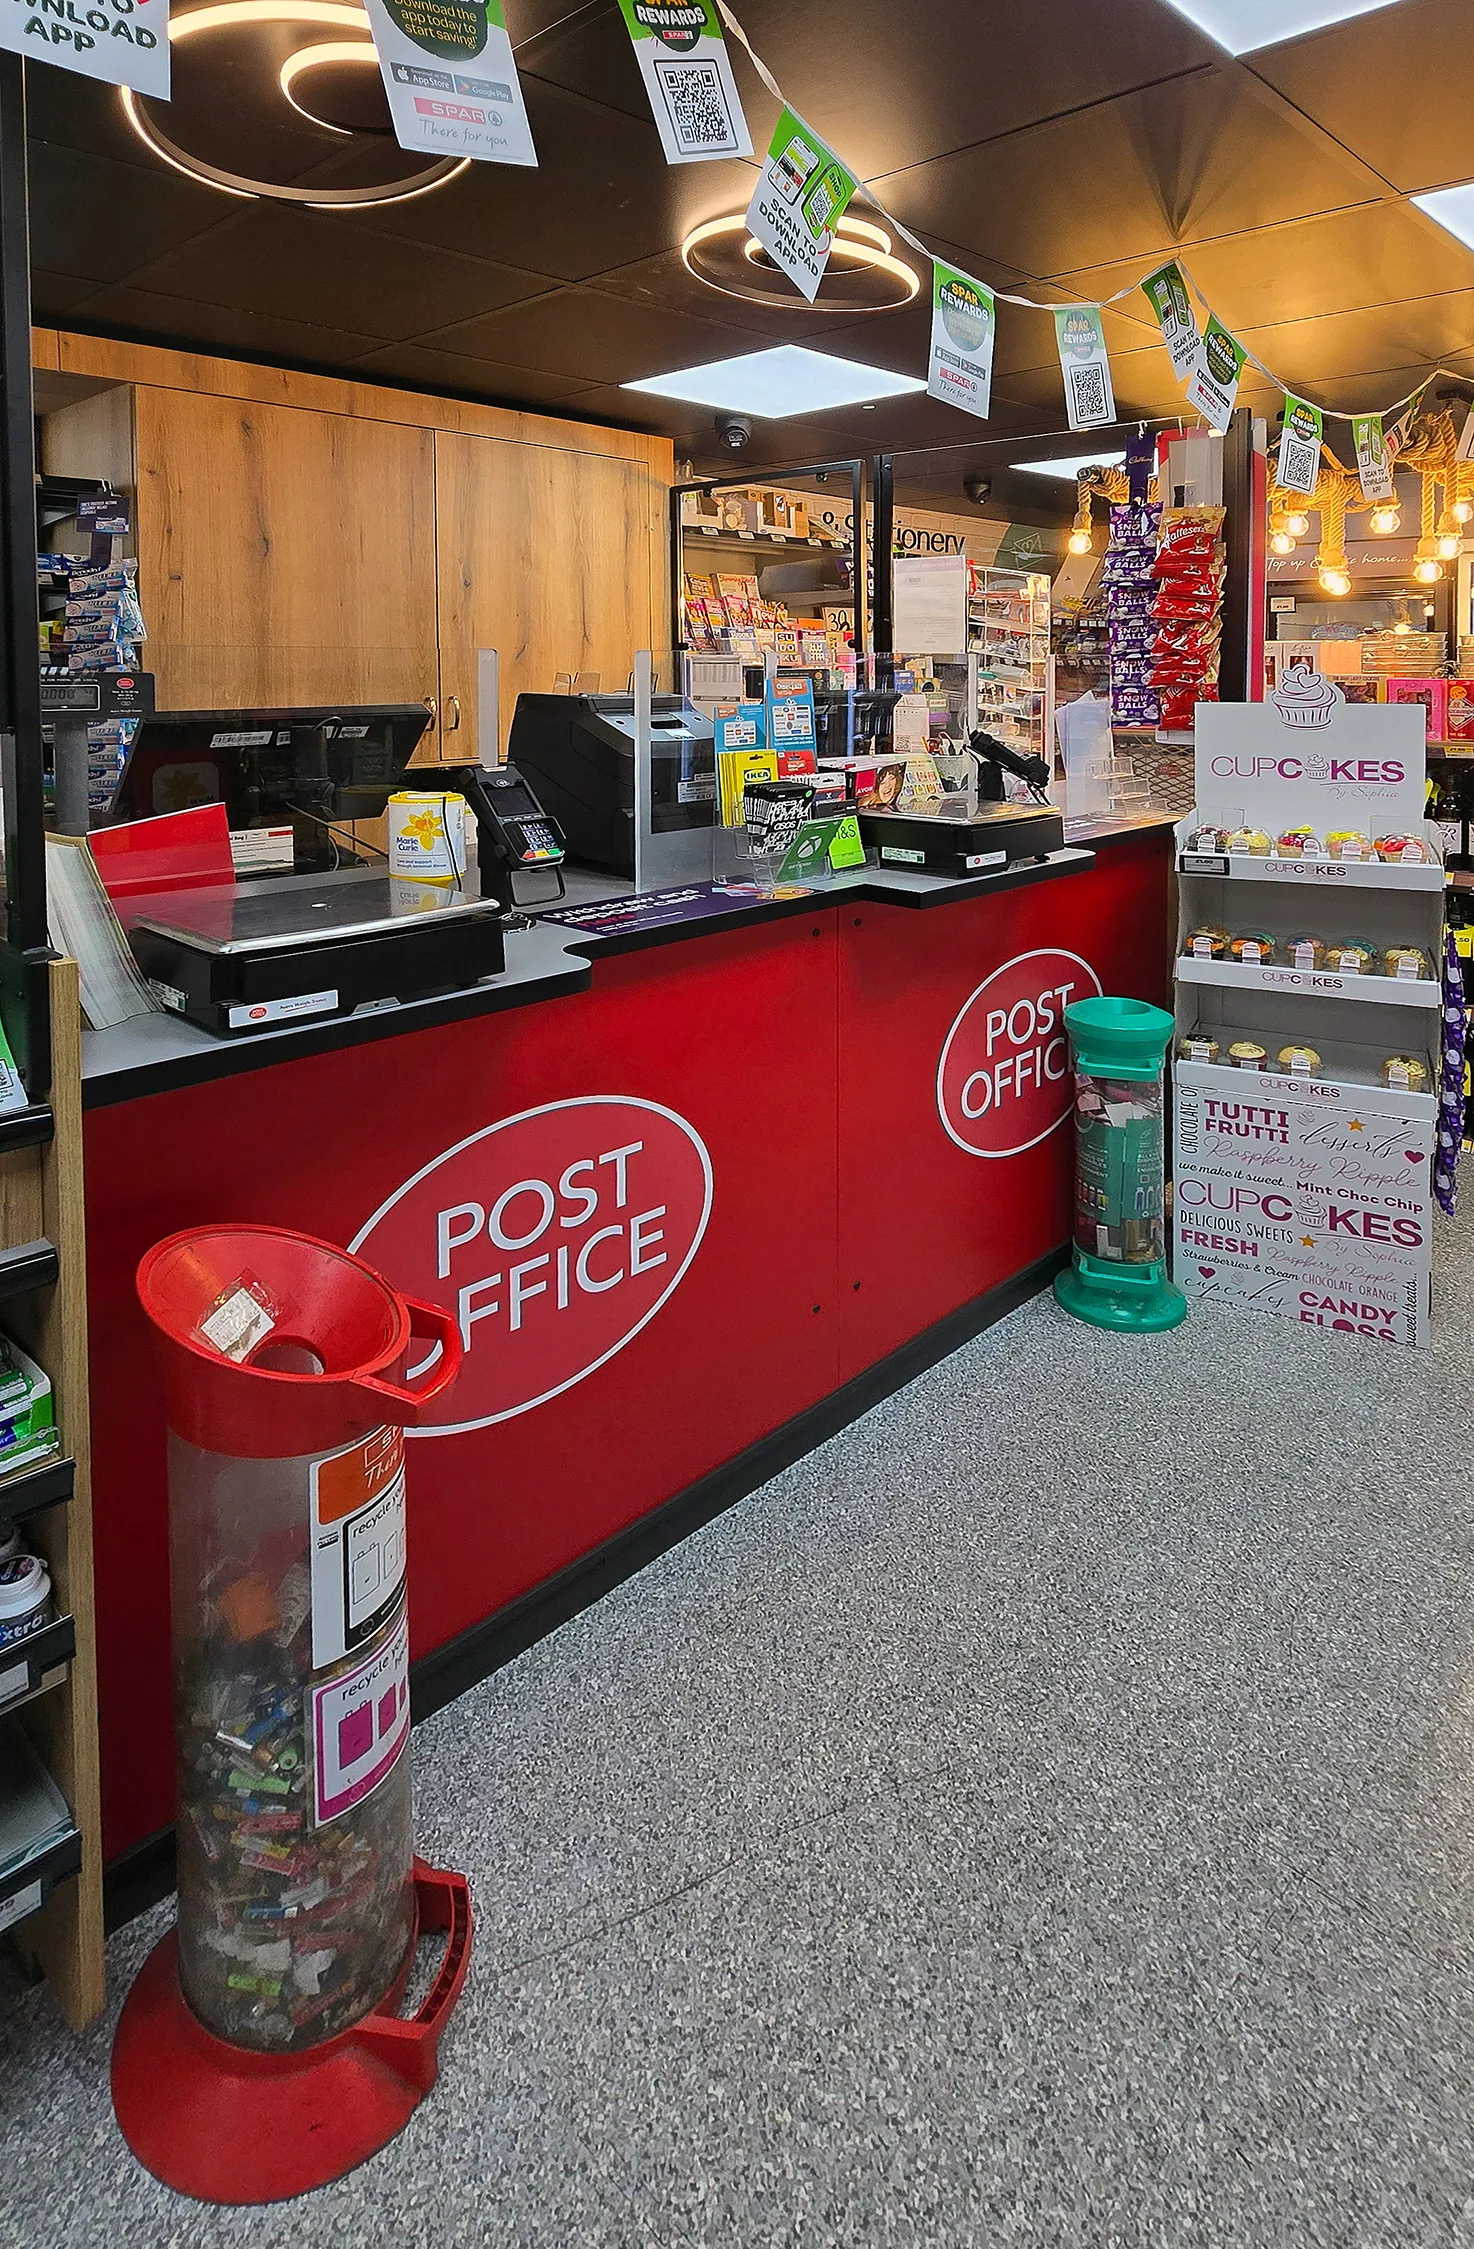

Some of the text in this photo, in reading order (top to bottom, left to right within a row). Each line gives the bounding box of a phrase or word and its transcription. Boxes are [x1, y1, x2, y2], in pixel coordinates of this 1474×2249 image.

[13, 0, 157, 49] NLOAD
[401, 10, 476, 34] app today to
[457, 8, 477, 22] the
[636, 4, 705, 25] REWARDS
[24, 16, 96, 52] APP
[405, 23, 435, 38] start
[413, 75, 450, 89] App Store
[472, 86, 496, 98] Google
[431, 102, 485, 122] SPAR
[419, 119, 458, 138] There
[462, 127, 482, 144] for
[486, 136, 508, 151] you
[829, 172, 841, 197] SHOP
[771, 198, 817, 256] SCAN TO
[759, 201, 819, 277] DOWNLOAD
[774, 240, 798, 265] APP
[940, 287, 989, 322] REWARDS
[951, 282, 978, 306] SPAR
[1068, 320, 1089, 332] SPAR
[1063, 331, 1097, 344] REWARDS
[1172, 330, 1195, 350] SCAN TO
[1217, 335, 1233, 357] SPAR
[1172, 337, 1200, 363] DOWNLOAD
[1185, 353, 1196, 367] APP
[1208, 335, 1237, 371] REWARDS
[946, 371, 971, 390] SPAR
[1290, 415, 1318, 433] REWARDS
[1296, 408, 1314, 422] SPAR
[1364, 468, 1385, 479] SCAN TO
[1364, 476, 1389, 488] DOWNLOAD
[1372, 486, 1382, 494] APP
[1117, 523, 1142, 531] SNO
[1267, 556, 1287, 572] Top
[1290, 560, 1306, 571] up
[1117, 590, 1149, 599] SNOW
[1118, 597, 1149, 606] BALLS
[752, 608, 776, 623] new
[778, 633, 794, 641] SU
[1117, 626, 1149, 634] SNOW
[1117, 632, 1148, 641] BALLS
[778, 644, 794, 652] DO
[1114, 659, 1146, 667] SNOW
[1115, 666, 1146, 674] BALLS
[1117, 694, 1148, 702] SNOW
[1118, 700, 1148, 709] BALLS
[746, 771, 769, 780] IKEA
[1210, 755, 1405, 783] CUPCKES
[857, 786, 873, 794] AVON
[1327, 785, 1400, 801] By Sophia
[397, 837, 418, 845] Marie
[398, 843, 418, 852] Curie
[1264, 862, 1347, 877] CUPCKES
[543, 888, 699, 919] Withdraw and
[564, 903, 654, 924] deposit
[654, 894, 707, 908] cash
[577, 913, 636, 927] here
[1261, 971, 1343, 989] CUPCKES
[986, 982, 1076, 1057] POST
[960, 1035, 1077, 1121] OFFIC
[1259, 1077, 1341, 1098] CUPCKES
[1204, 1099, 1289, 1128] TUTTI
[1179, 1101, 1199, 1154] CHOCOLATE
[1205, 1118, 1289, 1144] FRUTTI
[1299, 1121, 1423, 1158] desserts
[1179, 1161, 1197, 1172] we
[1198, 1165, 1233, 1178] make
[1233, 1170, 1244, 1180] it
[1203, 1135, 1421, 1189] Raspberry Ripple
[1296, 1181, 1424, 1214] Mint Choc Chip
[436, 1139, 643, 1279] POST
[1179, 1179, 1424, 1248] CUPCKES
[1180, 1210, 1294, 1244] DELICIOUS SWEETS
[1181, 1228, 1258, 1257] FRESH
[1182, 1248, 1299, 1281] Strawberries & Cream
[1266, 1247, 1401, 1284] Raspberry Ripple
[1354, 1244, 1418, 1267] Sophia
[1301, 1272, 1399, 1303] CHOCOLATE ORANGE
[1299, 1291, 1397, 1324] CANDY
[1401, 1312, 1418, 1347] sweet
[353, 1500, 391, 1539] recycle
[1, 1613, 43, 1642] xtra
[342, 1656, 389, 1701] recycle
